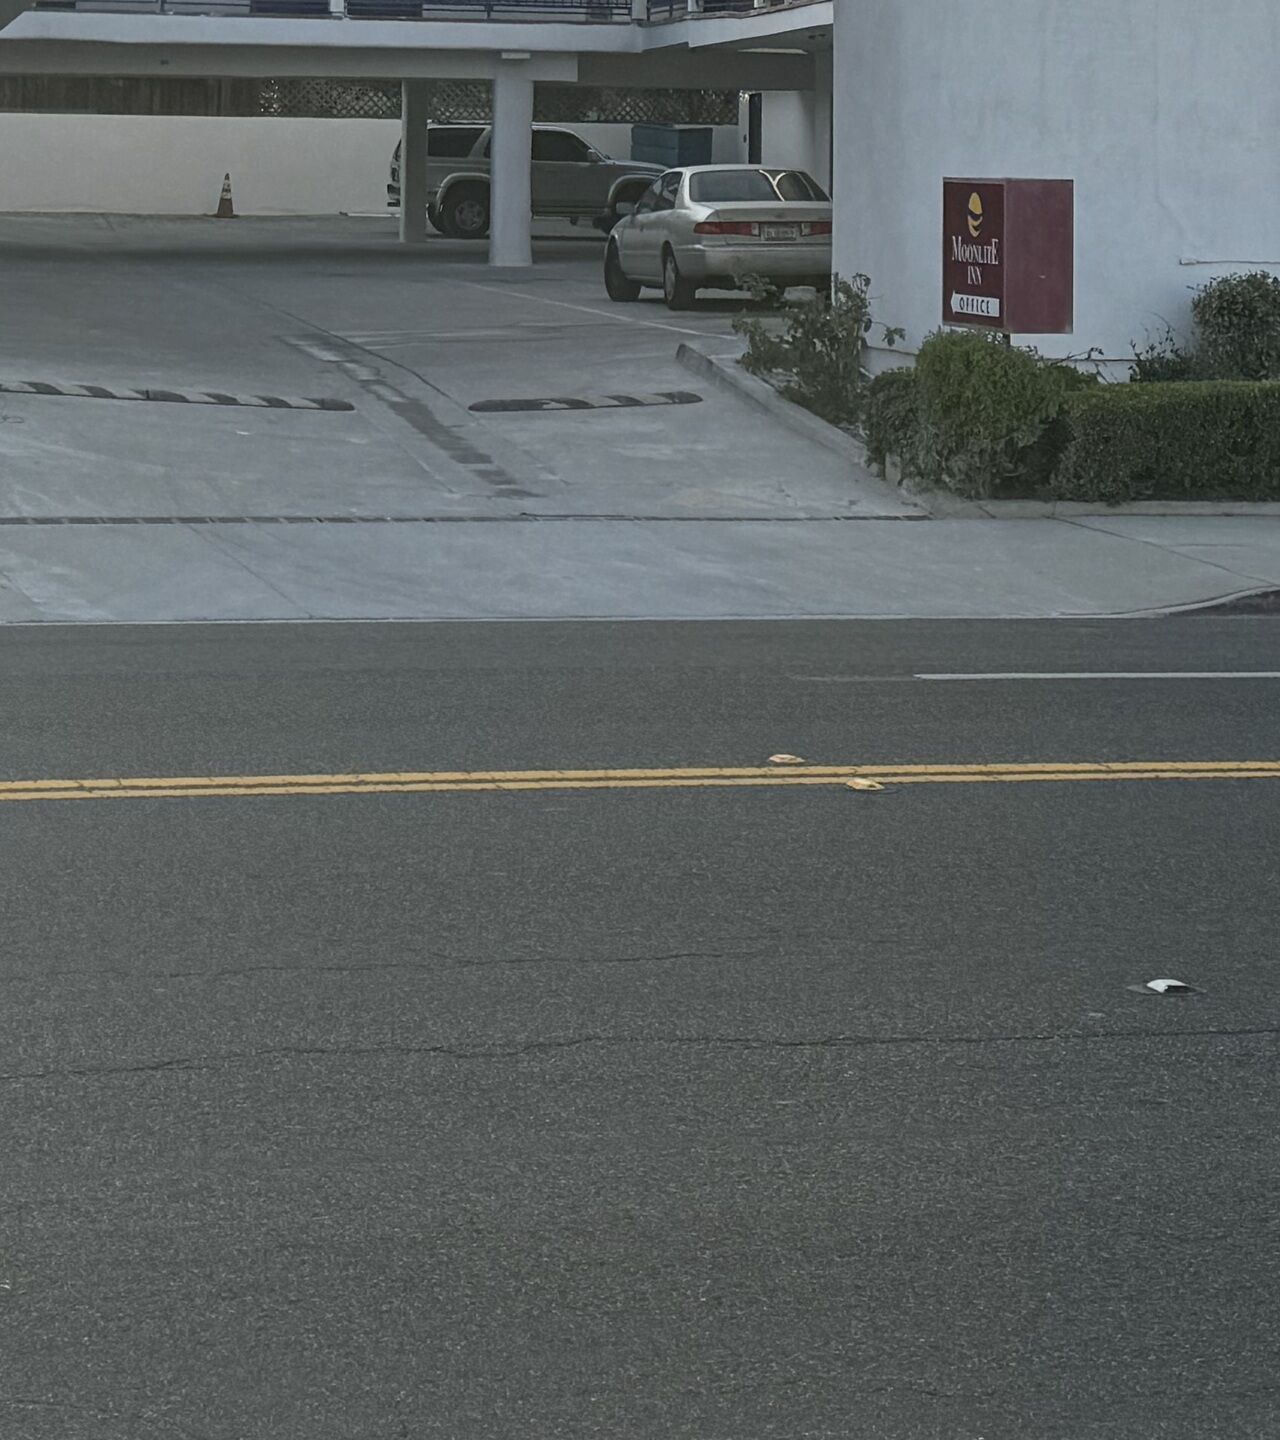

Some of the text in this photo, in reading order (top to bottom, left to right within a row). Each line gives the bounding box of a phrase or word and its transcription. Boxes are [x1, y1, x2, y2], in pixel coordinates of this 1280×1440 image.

[952, 236, 998, 264] MOONLITE
[967, 266, 982, 285] INN
[959, 297, 990, 314] OFFICE
